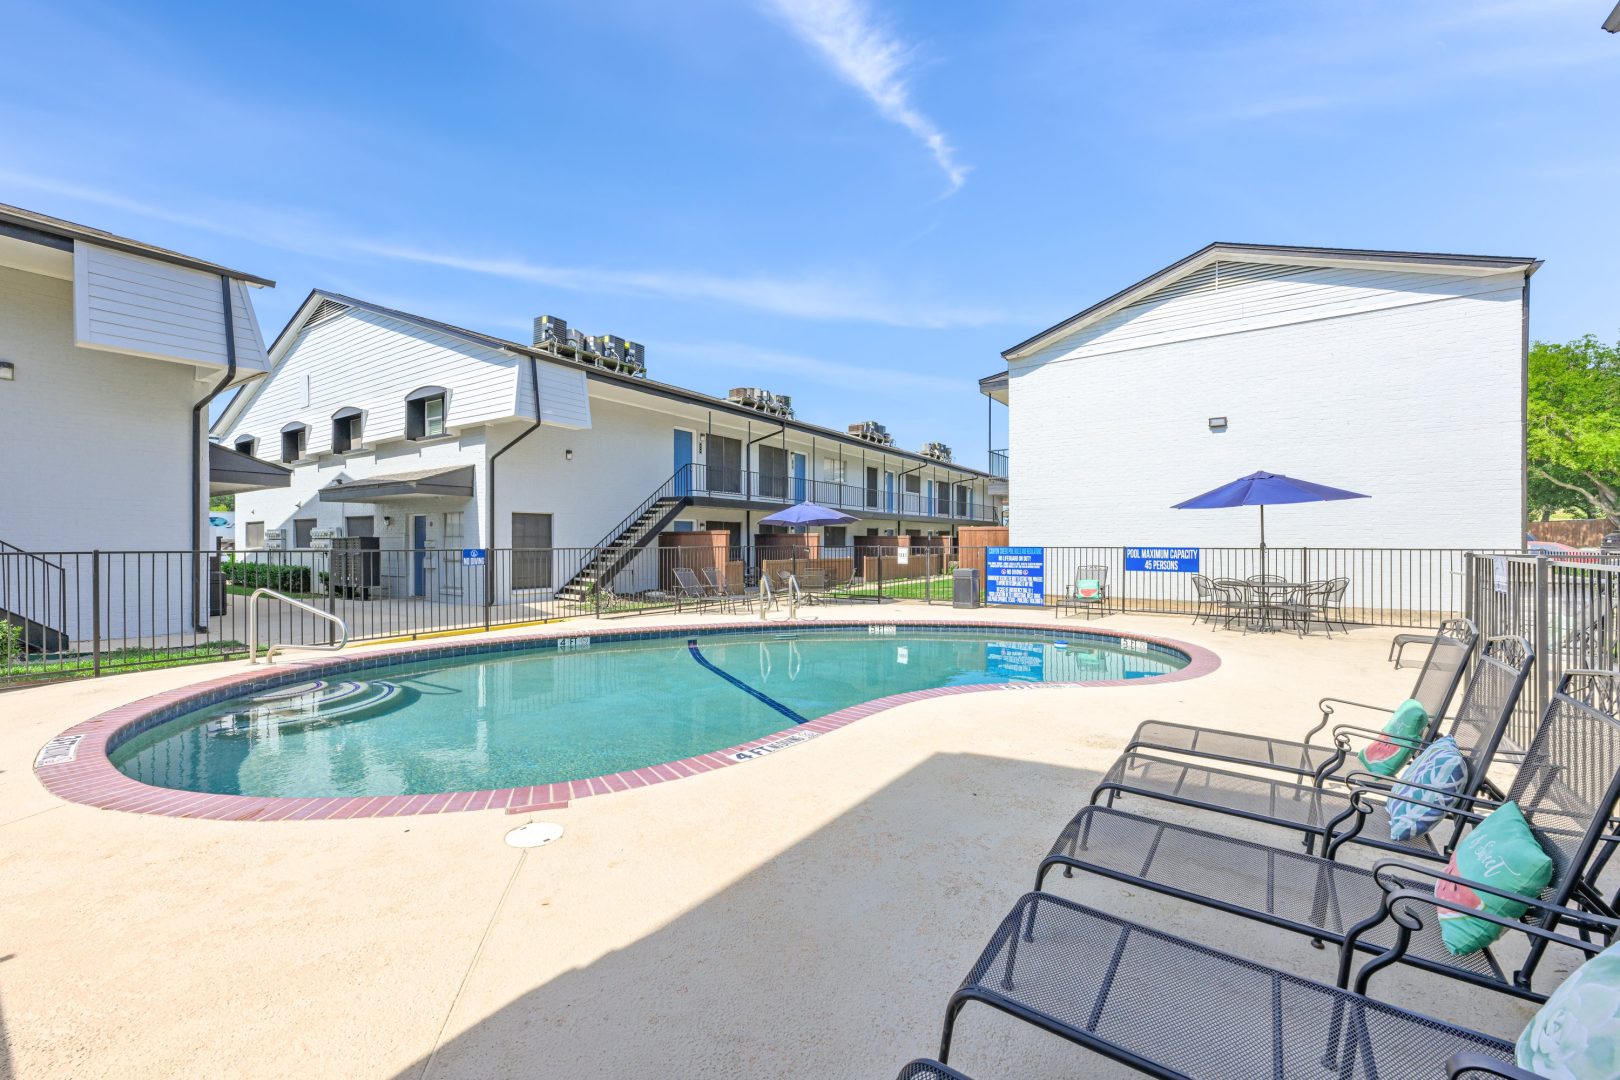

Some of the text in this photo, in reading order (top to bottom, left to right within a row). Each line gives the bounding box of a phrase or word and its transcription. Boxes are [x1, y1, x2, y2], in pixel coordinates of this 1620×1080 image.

[1127, 549, 1198, 559] POOL MAXIMUM CAPACITY
[1144, 560, 1179, 570] 45 PERSONS
[560, 638, 566, 646] 4
[736, 752, 753, 761] 4
